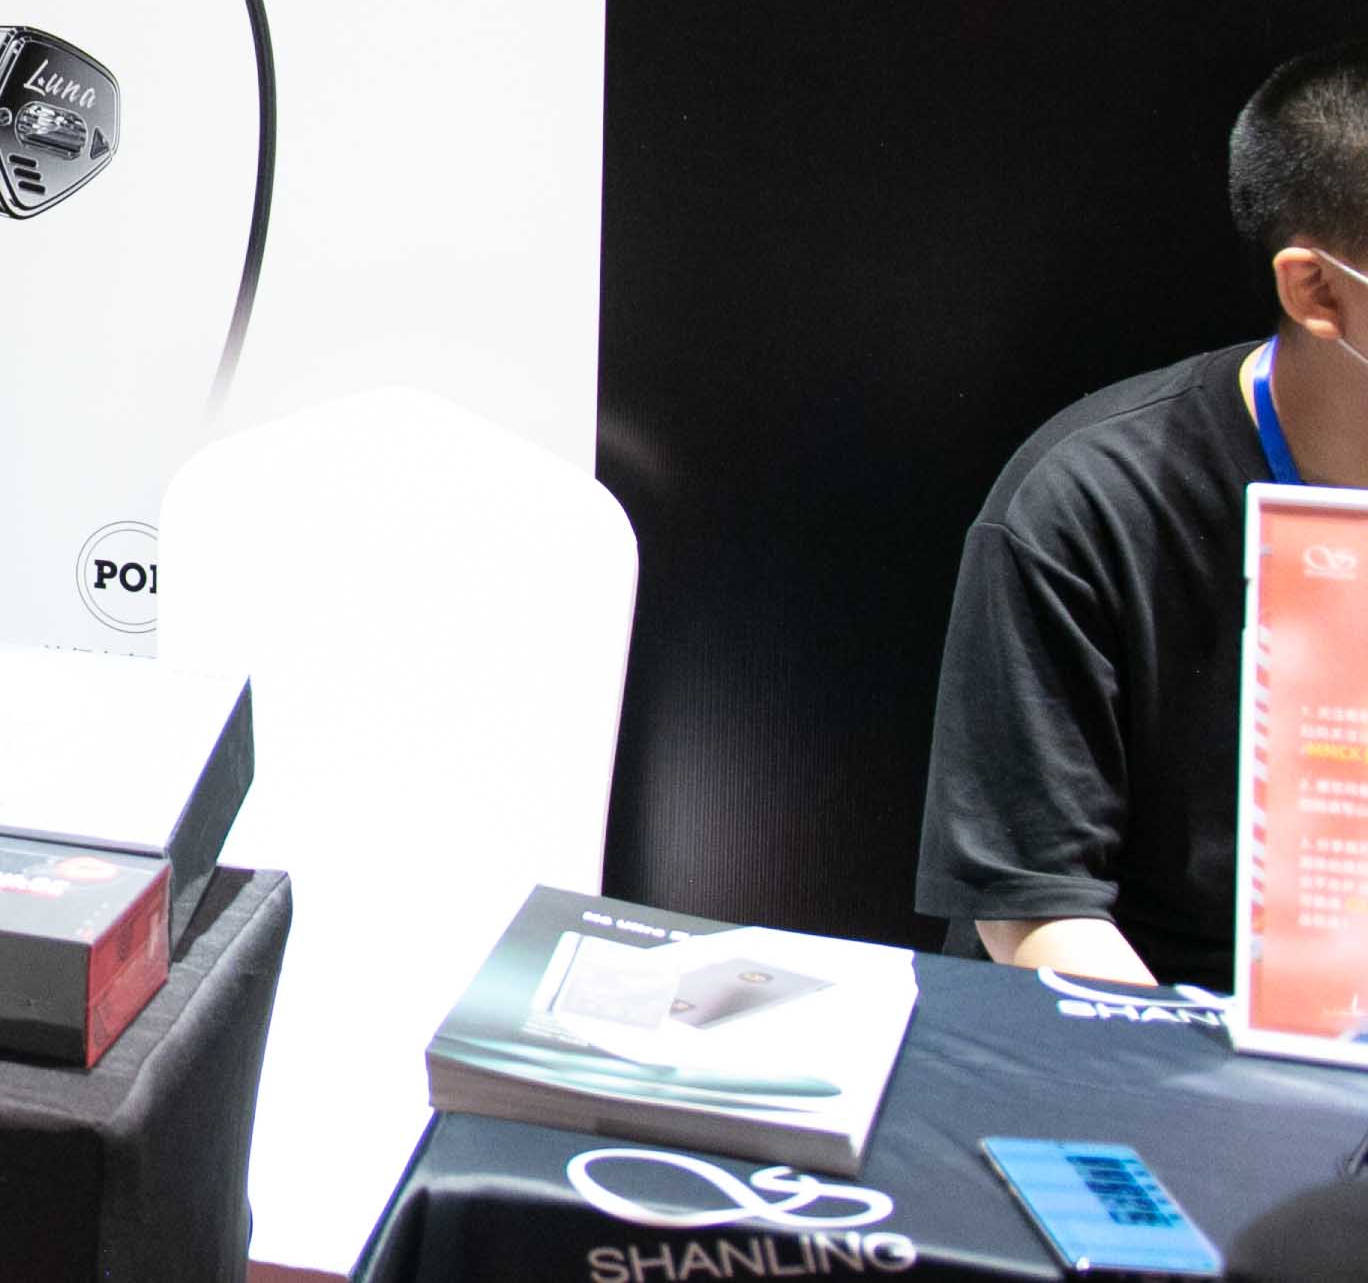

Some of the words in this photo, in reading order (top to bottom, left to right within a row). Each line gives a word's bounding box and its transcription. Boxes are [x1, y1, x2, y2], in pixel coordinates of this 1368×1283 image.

[23, 58, 97, 109] Luna
[1057, 999, 1221, 1026] SHAN
[587, 1230, 917, 1283] SHANLING
